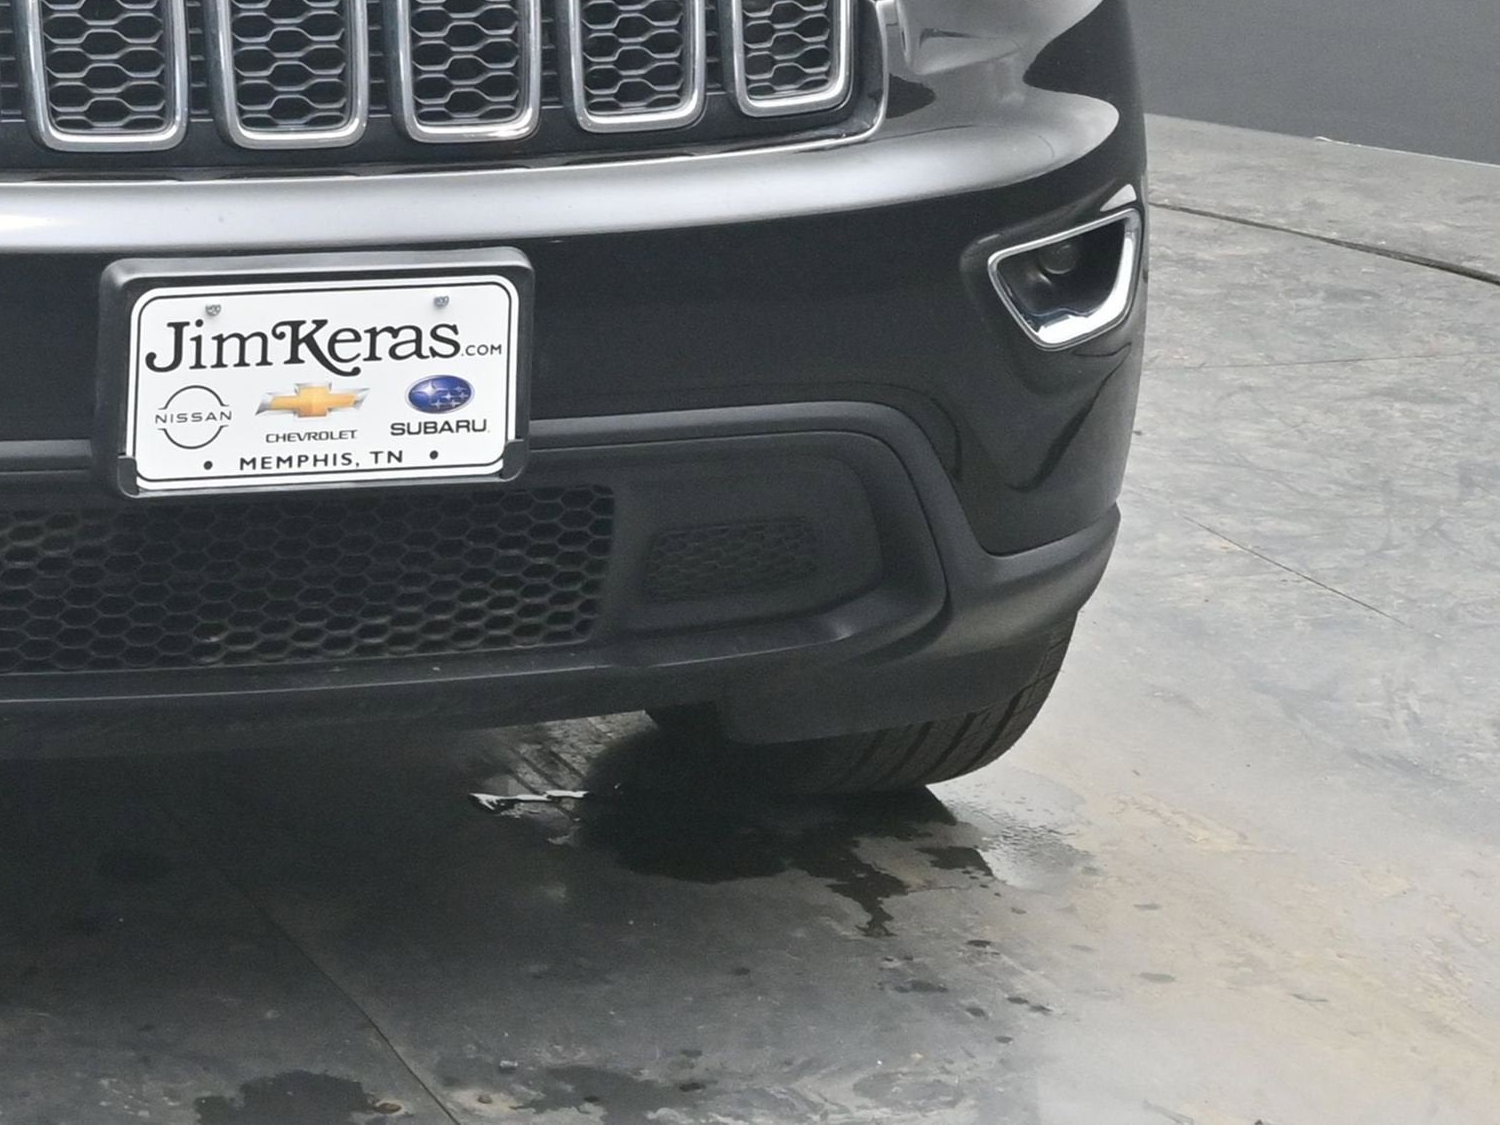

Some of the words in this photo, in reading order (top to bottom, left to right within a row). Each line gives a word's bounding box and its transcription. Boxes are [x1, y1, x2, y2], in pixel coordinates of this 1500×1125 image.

[155, 410, 232, 424] NISSAN
[390, 418, 488, 436] SUBARU
[265, 429, 359, 444] CHEVROLET
[239, 452, 360, 471] MEMPHIS,
[370, 450, 403, 465] TN
